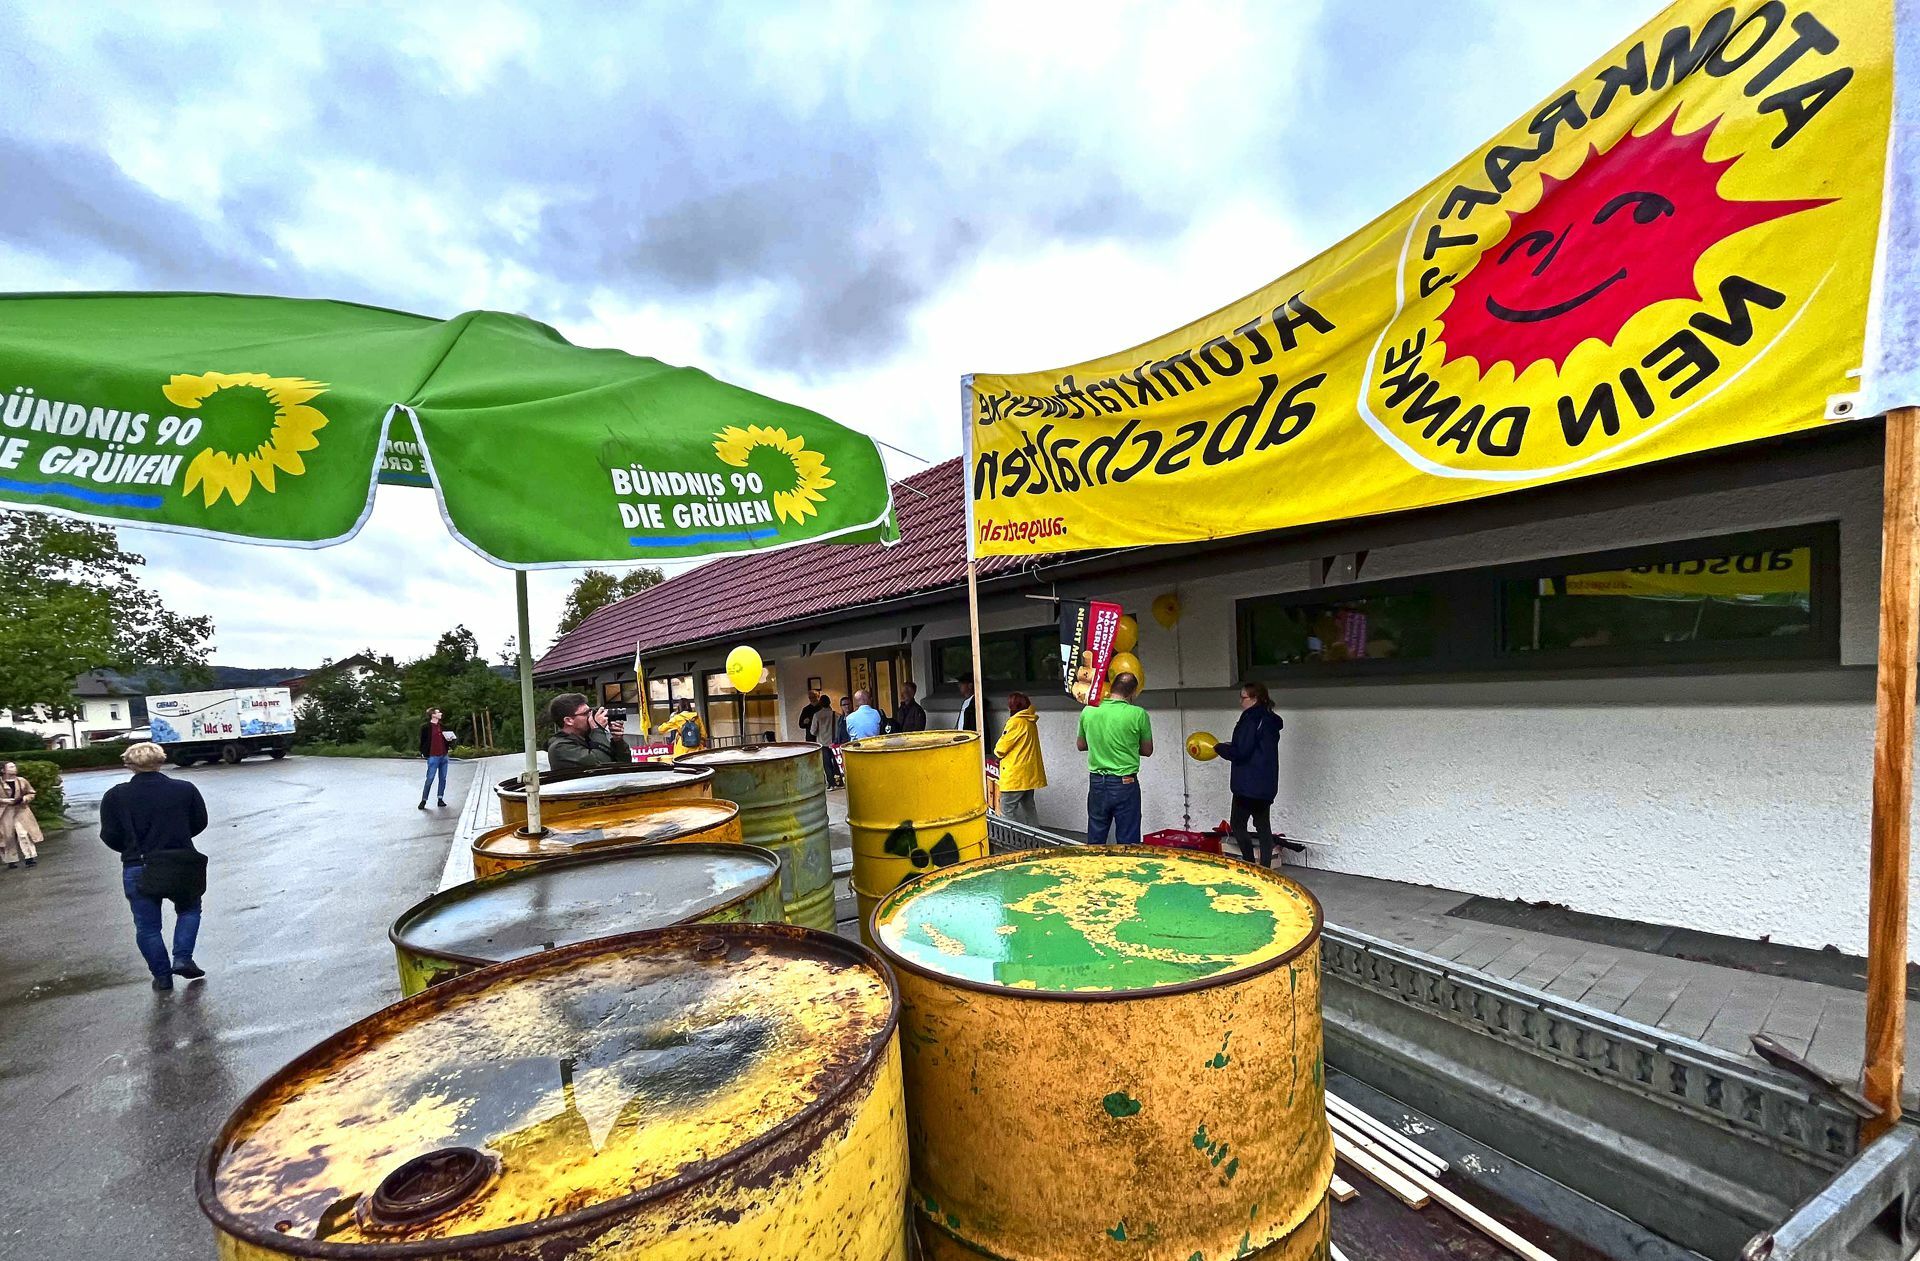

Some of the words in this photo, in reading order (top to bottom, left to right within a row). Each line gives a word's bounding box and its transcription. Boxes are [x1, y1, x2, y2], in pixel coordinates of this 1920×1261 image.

[0, 386, 150, 444] ÜNDNIS
[155, 416, 202, 446] 90
[39, 443, 184, 486] GRÜNEN
[610, 463, 726, 497] BÜNDNIS
[730, 472, 764, 495] 90
[618, 503, 665, 529] DIE
[672, 497, 774, 529] GRÜNEN
[1074, 607, 1085, 643] NICHT
[1070, 645, 1080, 666] MIT
